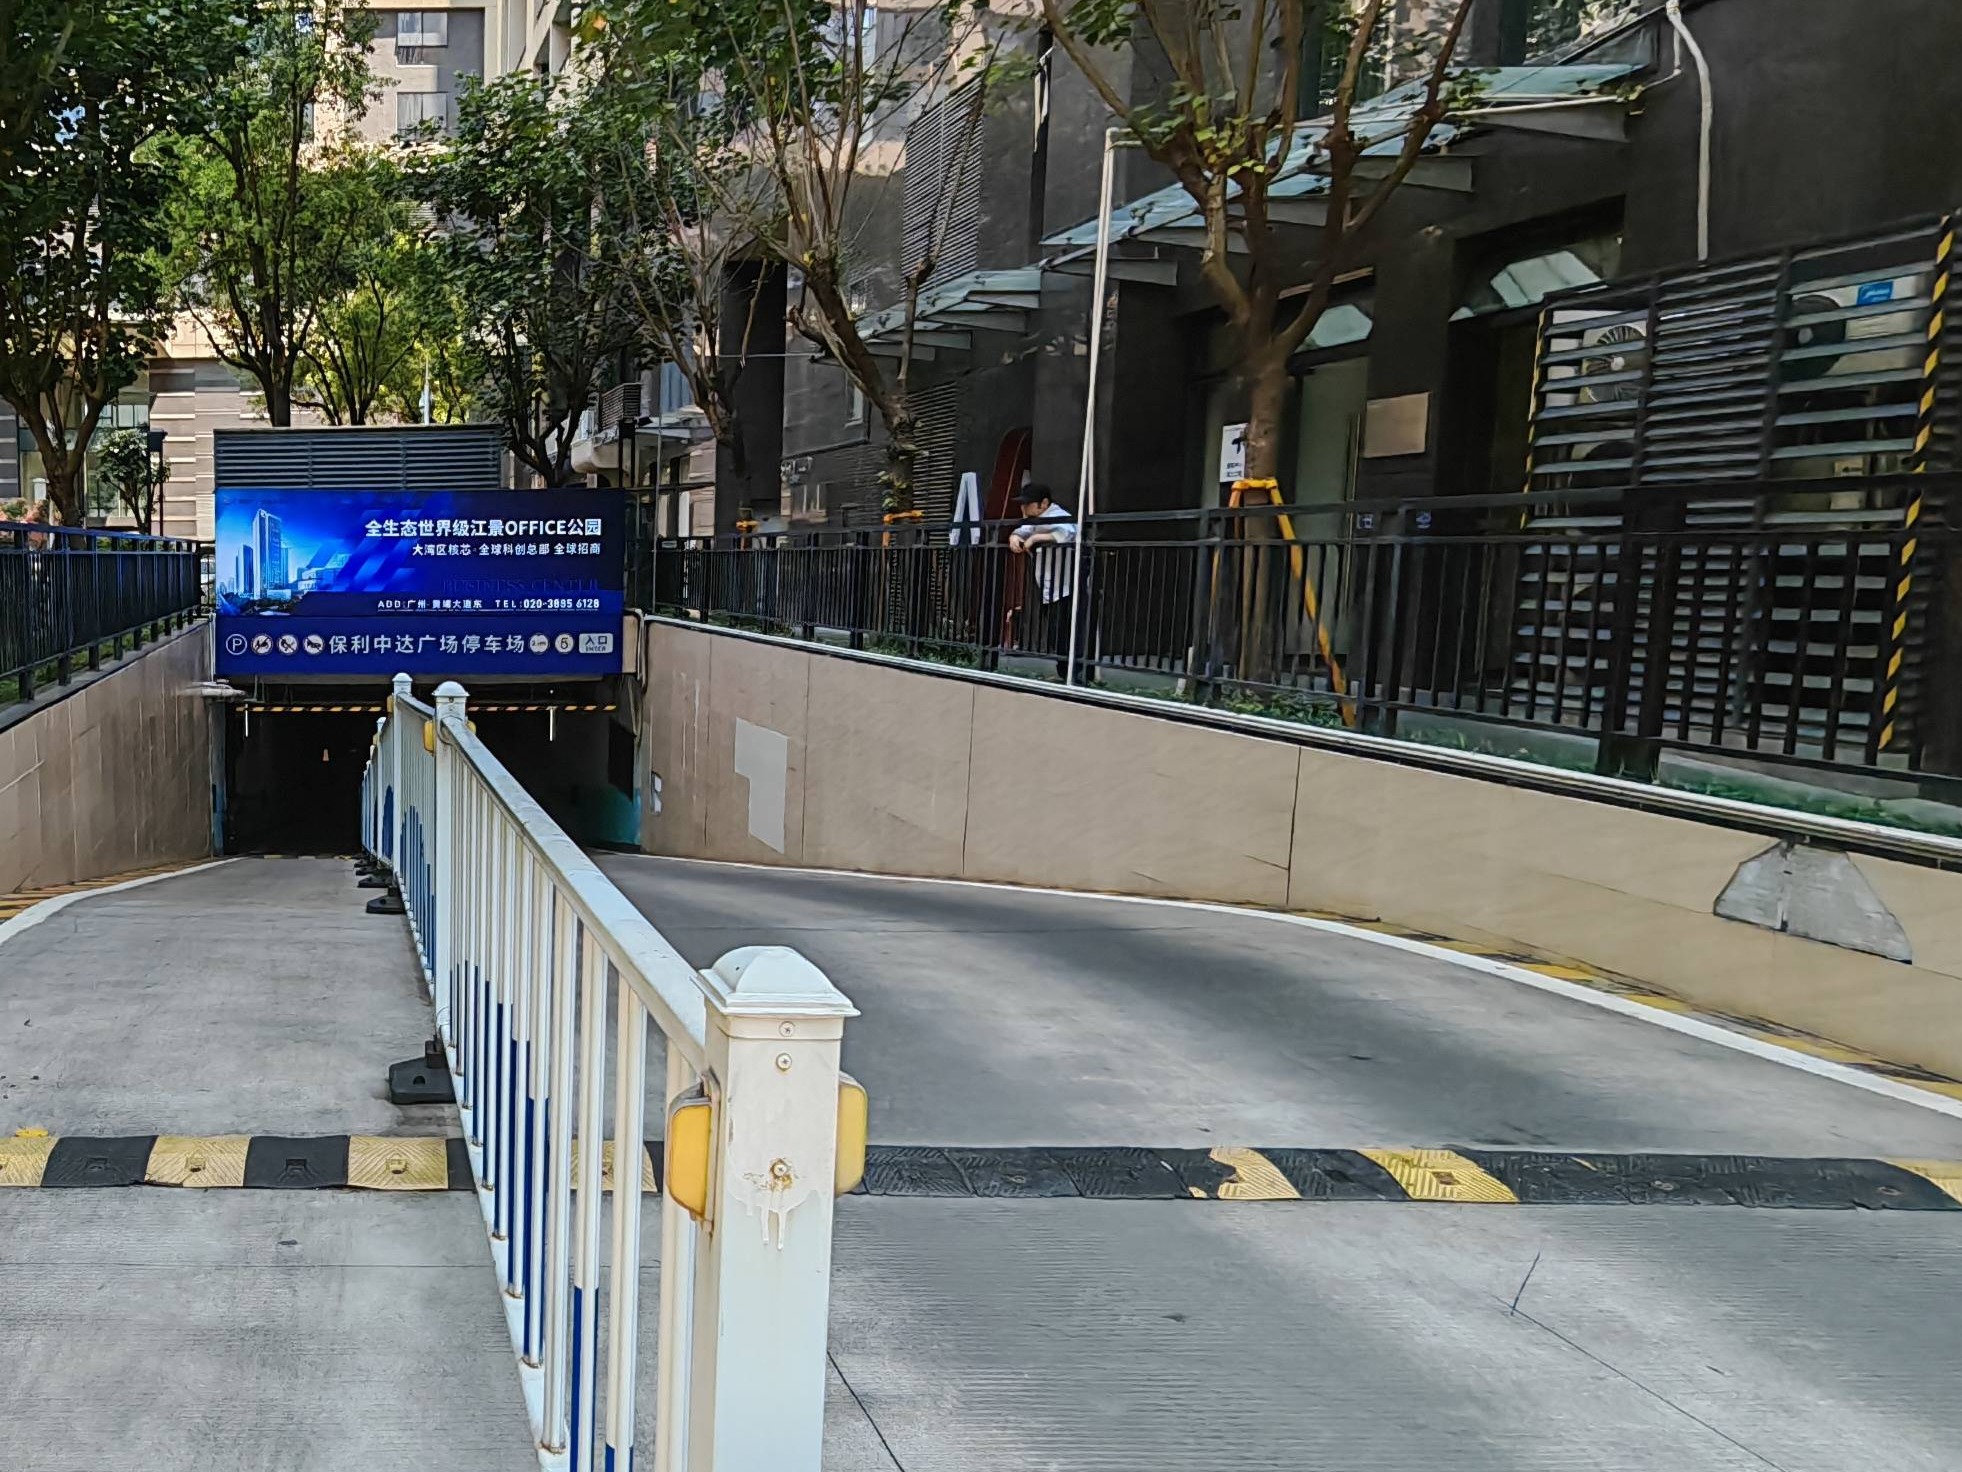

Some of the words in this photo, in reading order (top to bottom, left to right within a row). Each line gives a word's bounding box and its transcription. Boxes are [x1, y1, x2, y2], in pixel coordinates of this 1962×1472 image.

[365, 518, 602, 537] 全生态世界级江景OFFICE公园
[553, 543, 601, 555] 全球招商
[328, 634, 524, 654] 保利中达广场停车场
[585, 635, 608, 646] 入口
